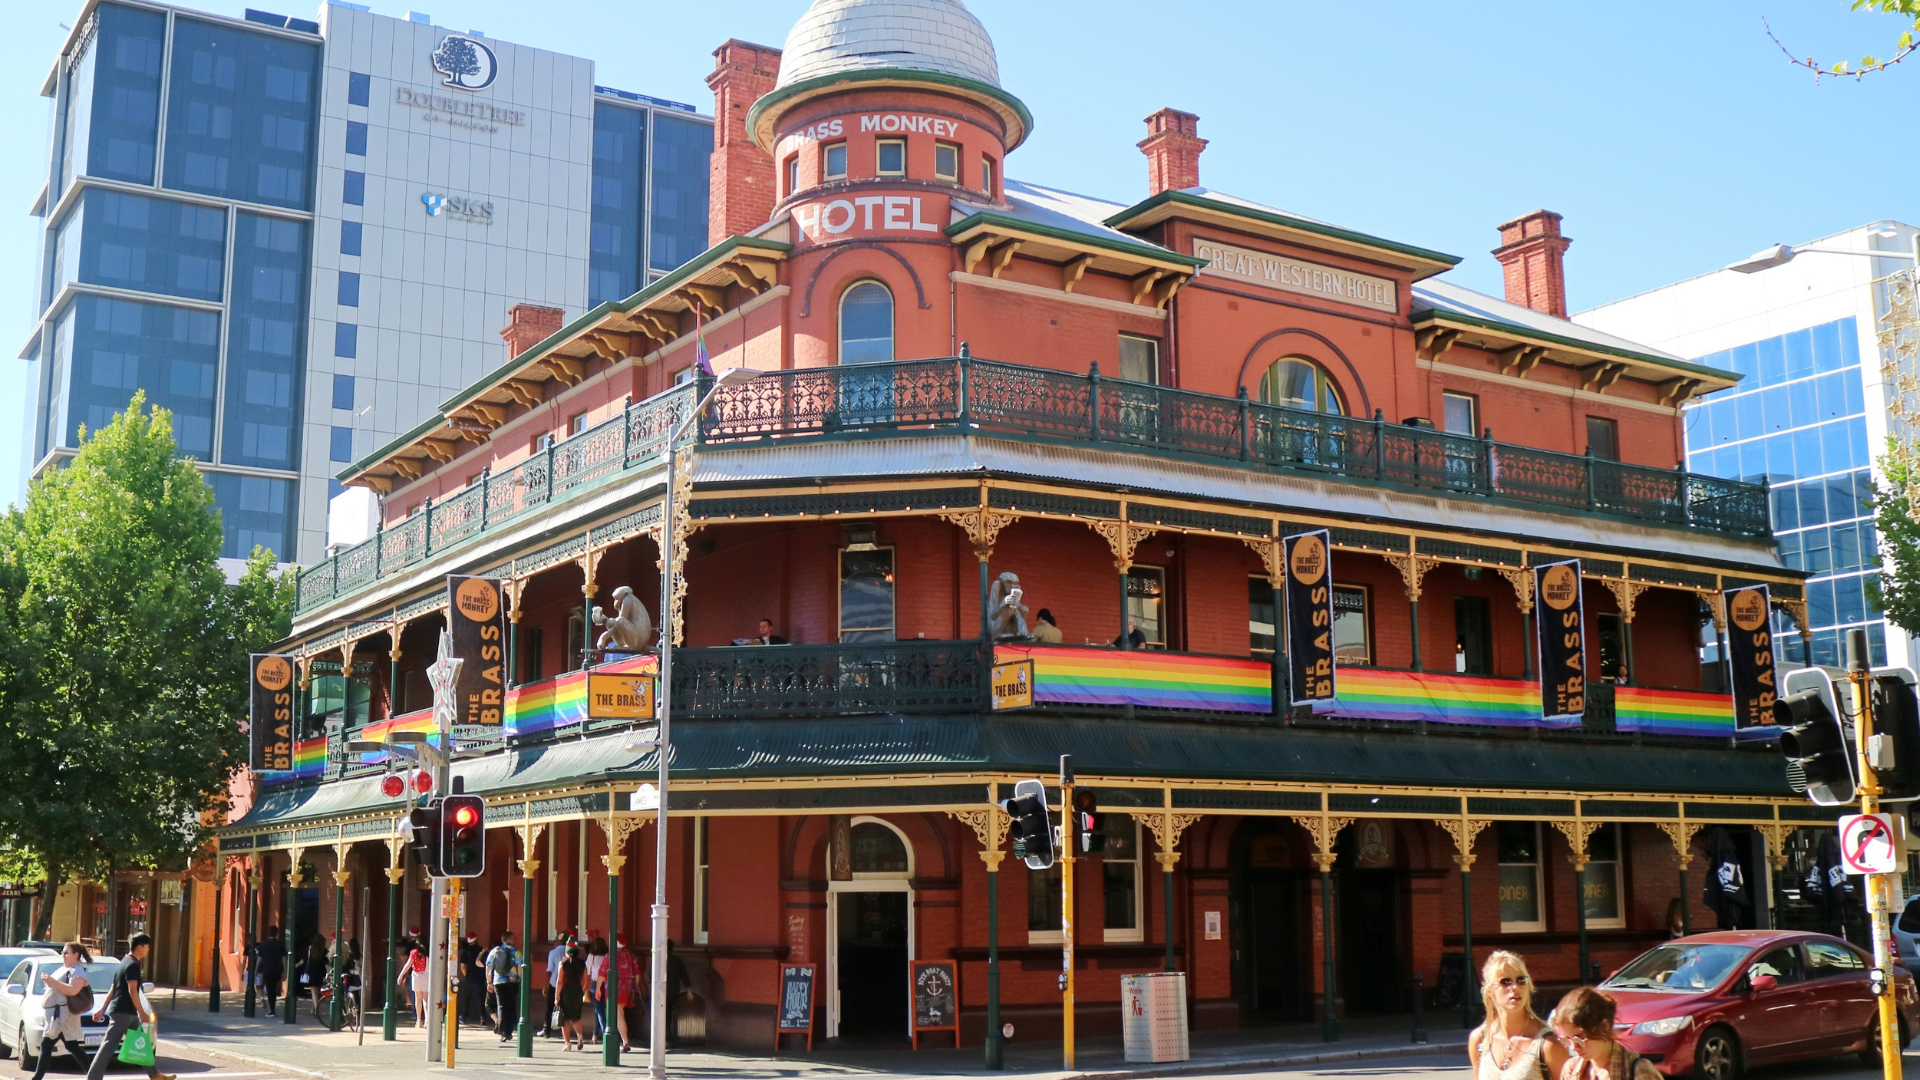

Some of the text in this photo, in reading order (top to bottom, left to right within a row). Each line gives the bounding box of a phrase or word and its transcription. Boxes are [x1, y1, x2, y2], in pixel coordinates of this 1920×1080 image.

[786, 114, 959, 152] BRASS MONKEY
[449, 196, 494, 219] SKS
[798, 196, 938, 242] HOTEL
[1261, 258, 1343, 296] WESTERN
[1296, 565, 1317, 574] MONKEY
[462, 603, 489, 614] MONKEY
[1547, 592, 1569, 600] MONKEY
[1736, 614, 1758, 622] MONKEY
[1311, 586, 1331, 698] BRASS
[480, 624, 501, 724] BRASS
[1562, 611, 1584, 713] BRASS
[995, 682, 1027, 698] THE BRASS
[1306, 665, 1315, 698] THE
[1753, 631, 1779, 725] BRASS
[468, 693, 480, 723] THE
[596, 693, 647, 707] THE BRASS
[1557, 683, 1566, 712] THE
[1749, 698, 1759, 725] THE
[274, 692, 291, 769] BRASS
[264, 745, 273, 769] THE
[1499, 885, 1529, 901] DINER
